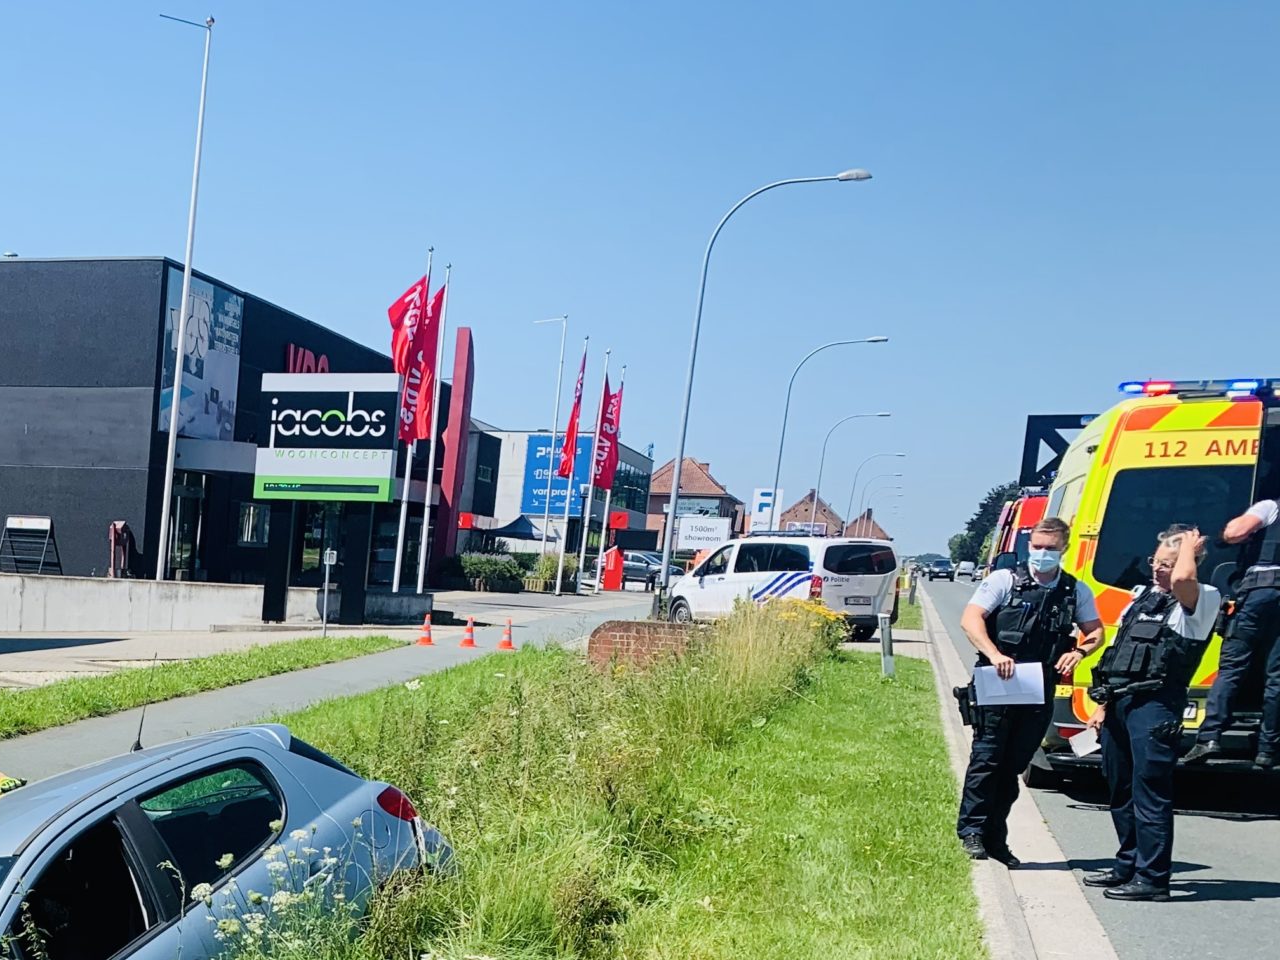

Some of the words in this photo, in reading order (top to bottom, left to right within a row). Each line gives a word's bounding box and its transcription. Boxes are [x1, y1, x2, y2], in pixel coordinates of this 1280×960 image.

[268, 391, 387, 449] jacobs
[274, 449, 389, 460] WOONCONCEPT
[1144, 440, 1188, 459] 112
[551, 488, 578, 498] prat.
[684, 533, 720, 543] showroom
